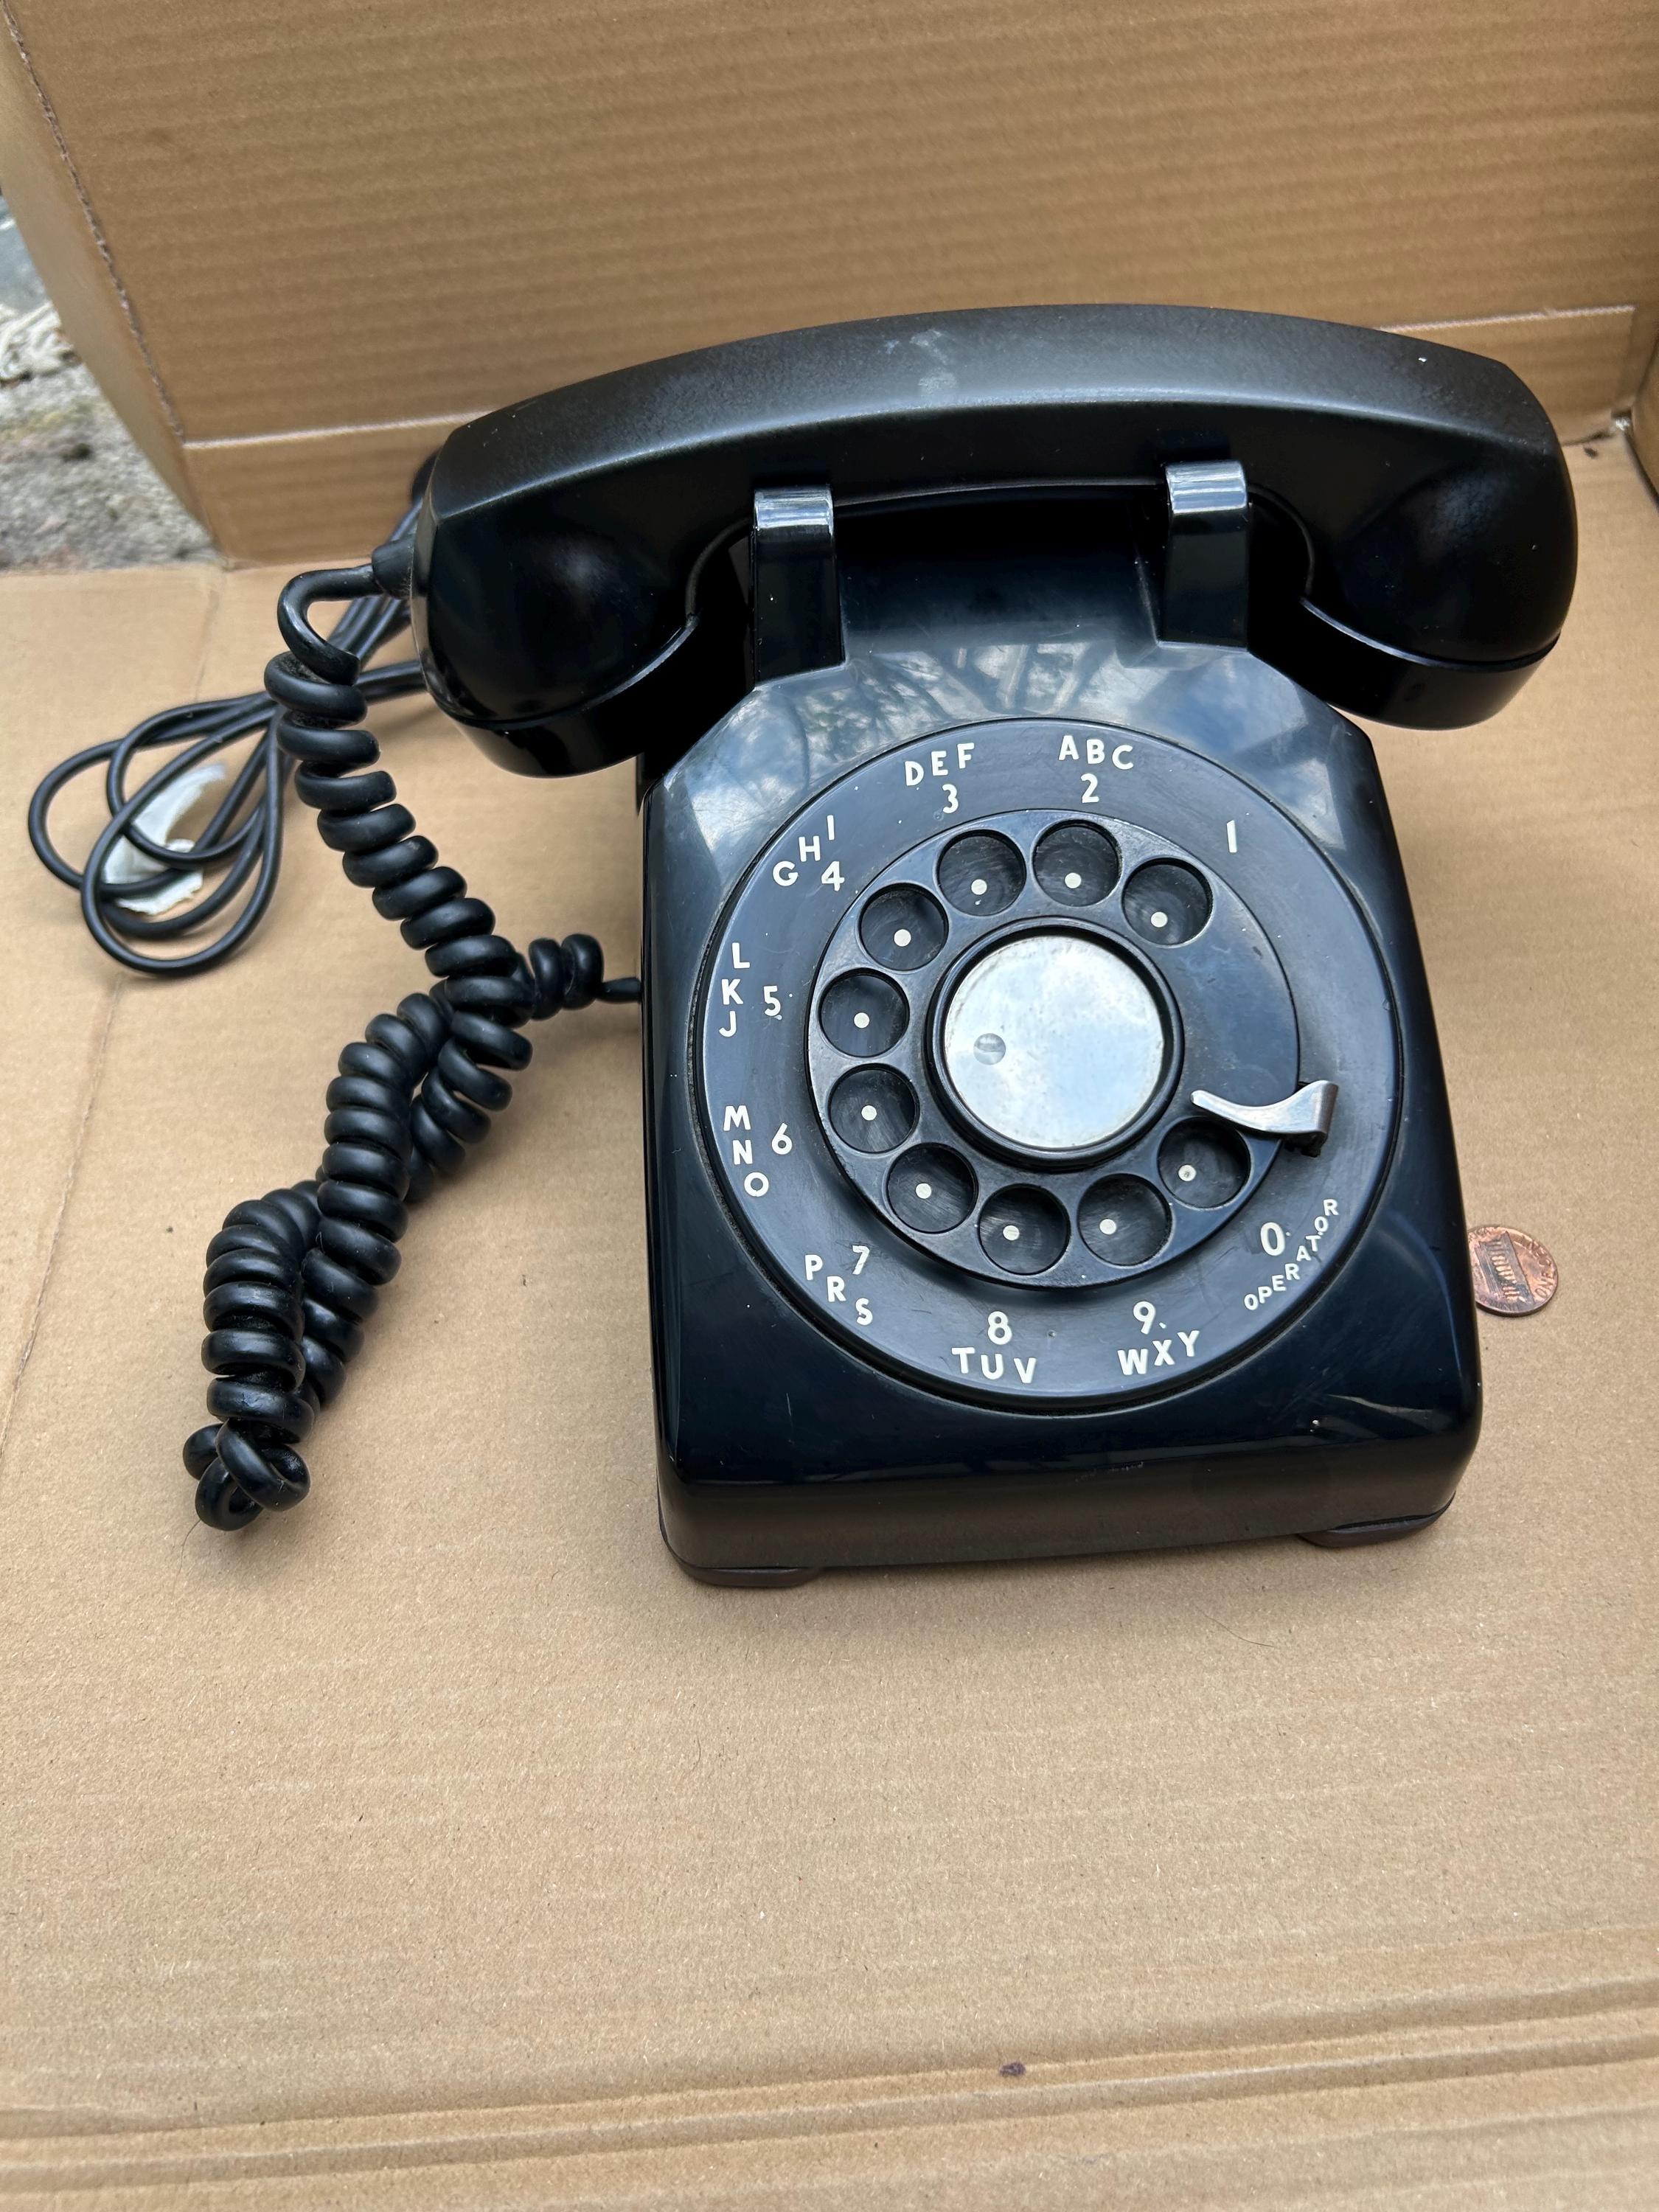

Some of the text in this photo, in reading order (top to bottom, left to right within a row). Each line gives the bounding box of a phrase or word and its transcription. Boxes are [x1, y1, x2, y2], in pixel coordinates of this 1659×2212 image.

[904, 742, 975, 786] DEF
[1058, 735, 1134, 770] ABC
[942, 784, 959, 813] 3
[1080, 773, 1099, 803] 2
[772, 815, 835, 886] GHI
[821, 860, 845, 891] 4
[763, 985, 782, 1017] 5
[723, 1105, 769, 1197] MNO
[771, 1122, 793, 1155] 6
[852, 1245, 870, 1276] 7
[1244, 1198, 1339, 1311] OPERATOR
[804, 1254, 873, 1326] PRS
[987, 1311, 1012, 1346] 8
[1133, 1301, 1156, 1335] 9
[952, 1346, 1037, 1384] TUV
[1117, 1330, 1200, 1376] WXY
